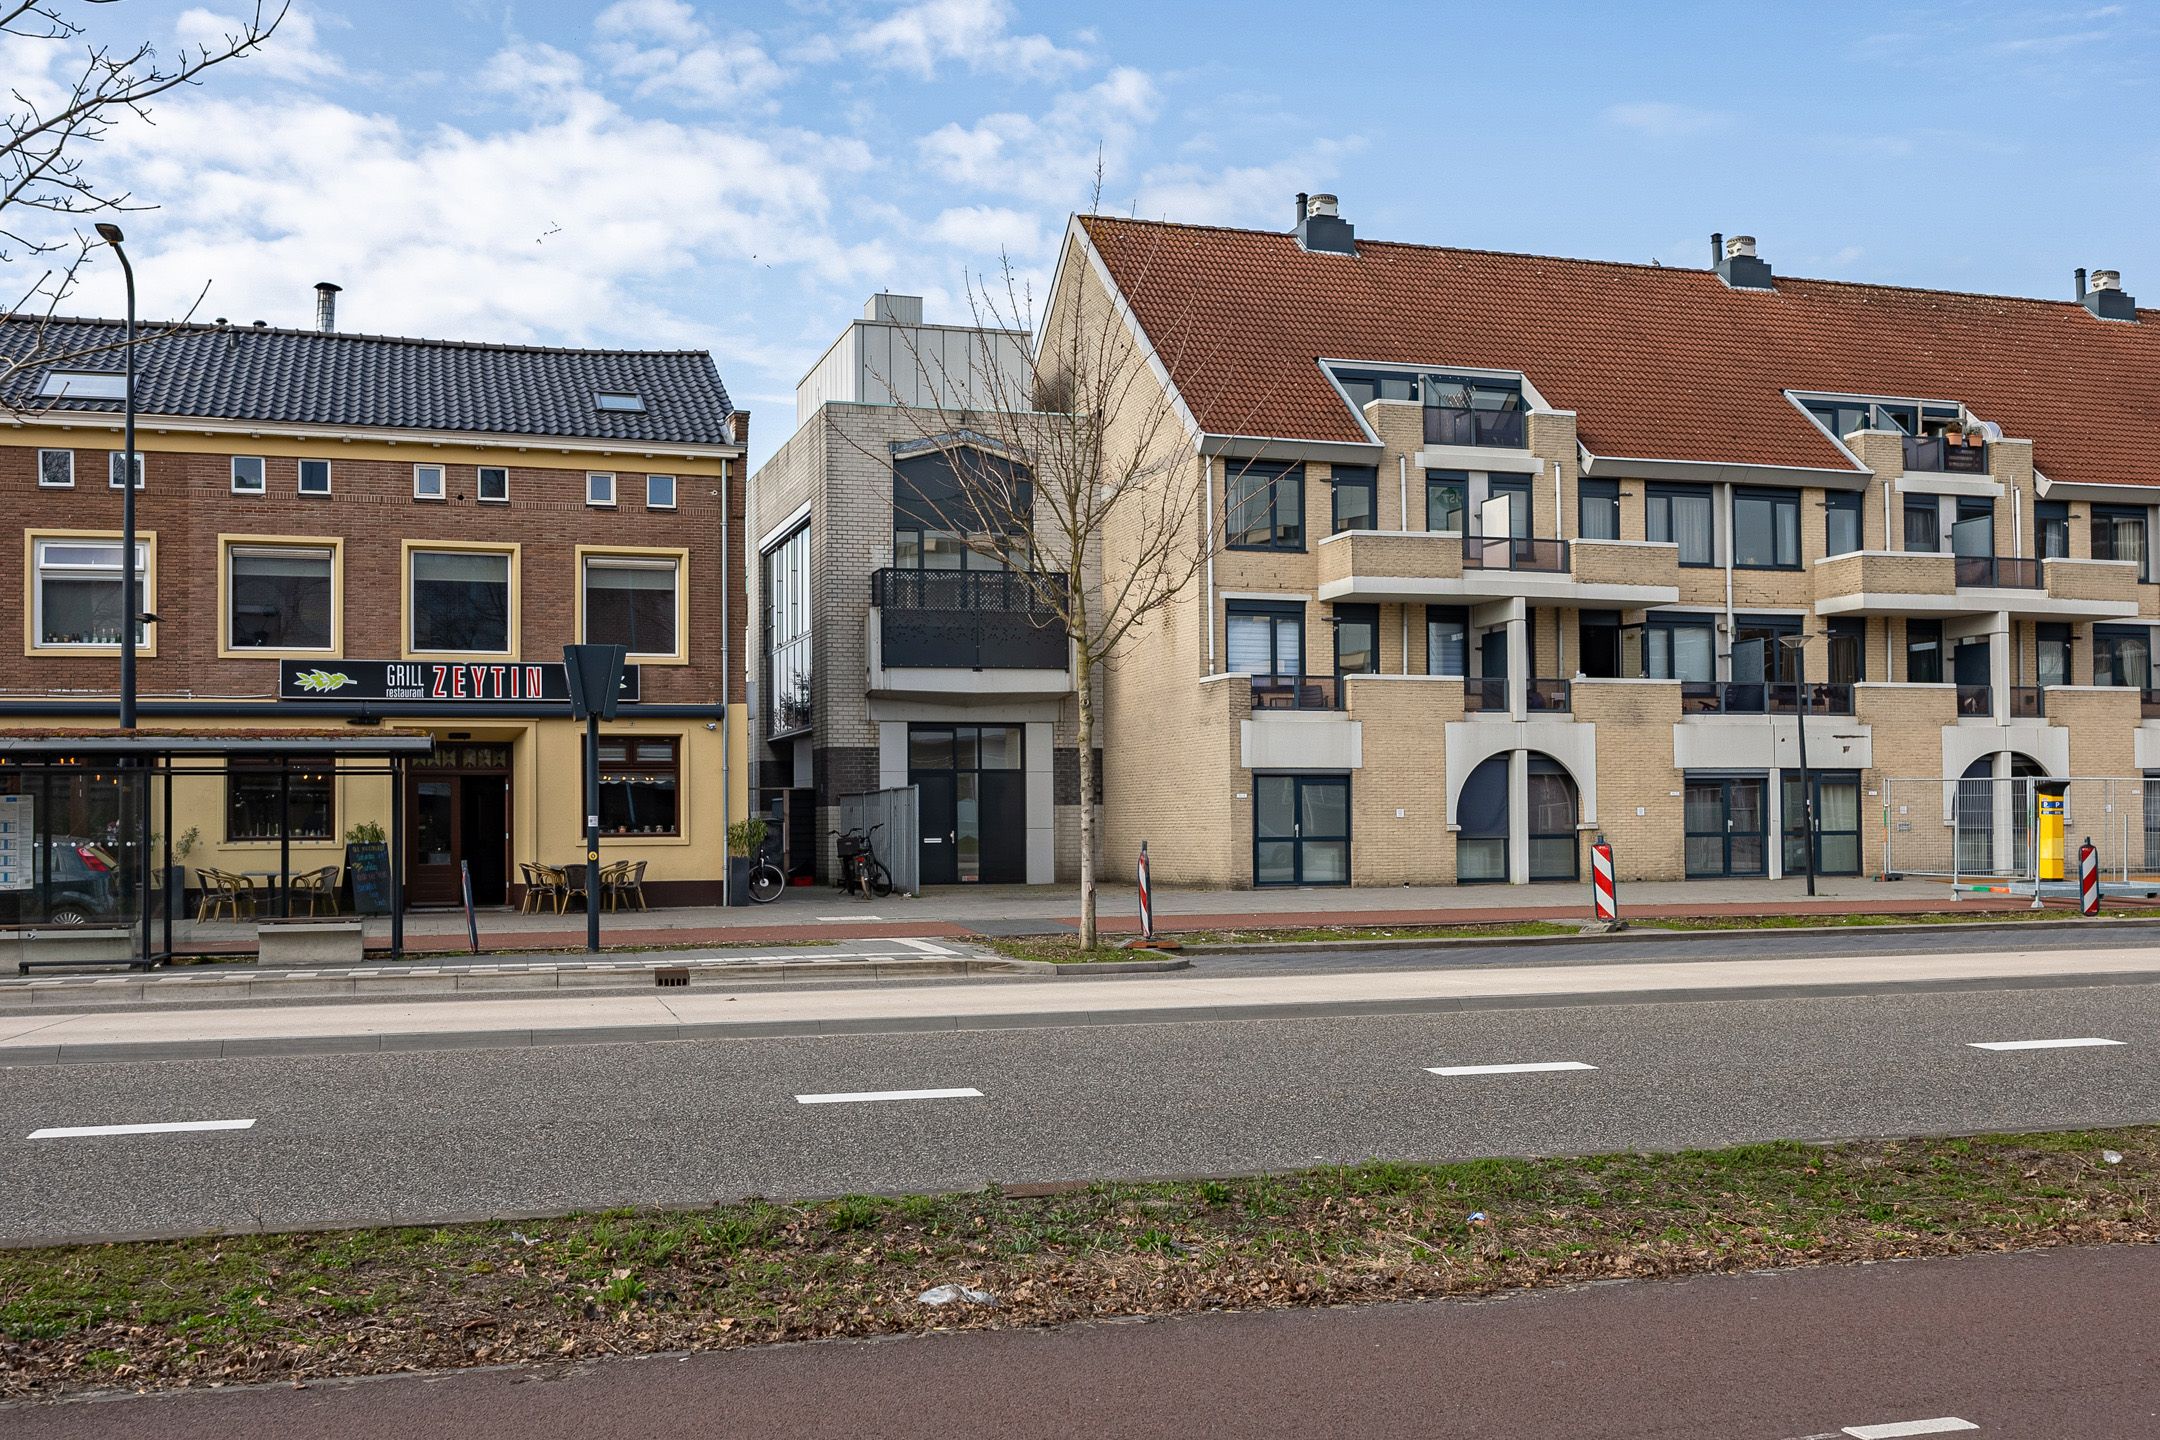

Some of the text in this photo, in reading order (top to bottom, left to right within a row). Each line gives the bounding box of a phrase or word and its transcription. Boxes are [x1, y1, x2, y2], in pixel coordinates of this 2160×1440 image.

[386, 664, 424, 687] GRILL
[433, 666, 542, 698] ZEYTIN
[386, 687, 424, 698] restaurant
